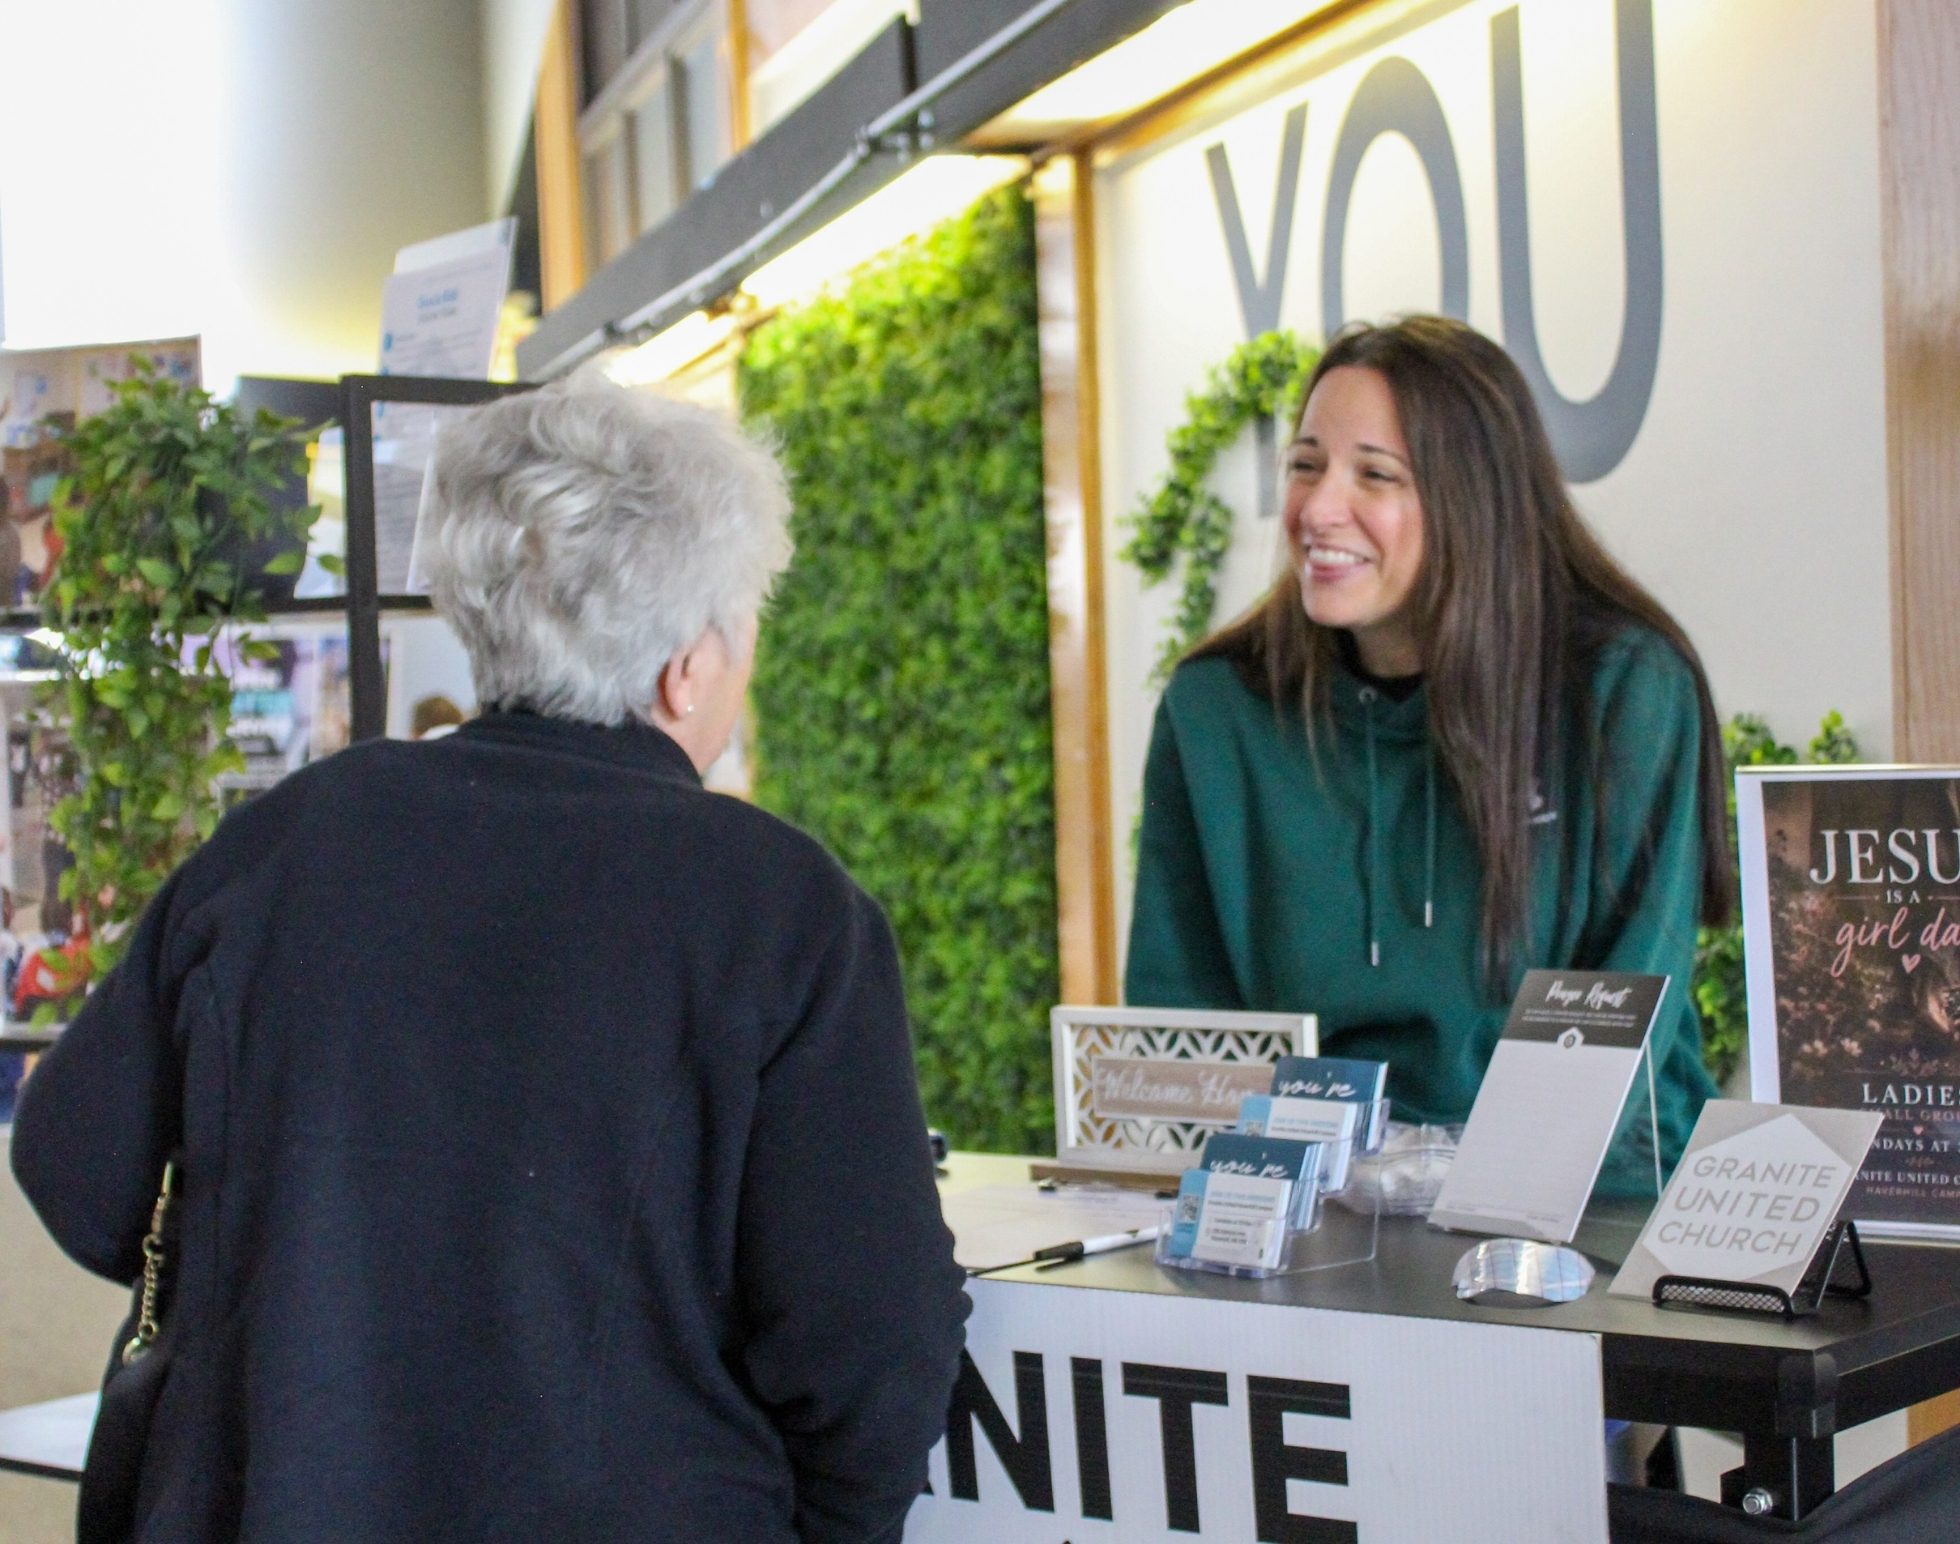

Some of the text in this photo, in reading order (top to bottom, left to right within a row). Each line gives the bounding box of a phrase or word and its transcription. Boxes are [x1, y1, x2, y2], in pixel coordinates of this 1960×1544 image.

[1204, 0, 1664, 518] YOU
[1886, 889, 1921, 904] IS A
[1830, 906, 1911, 978] girl
[1100, 1065, 1195, 1104] Welcome
[1862, 1083, 1960, 1106] LADIE
[1930, 1141, 1950, 1153] AT
[1693, 1156, 1836, 1189] GRANITE
[1897, 1172, 1950, 1185] UNITED
[1675, 1187, 1820, 1223] UNITED
[1658, 1221, 1803, 1256] CHURCH
[920, 1346, 1359, 1544] NITE
